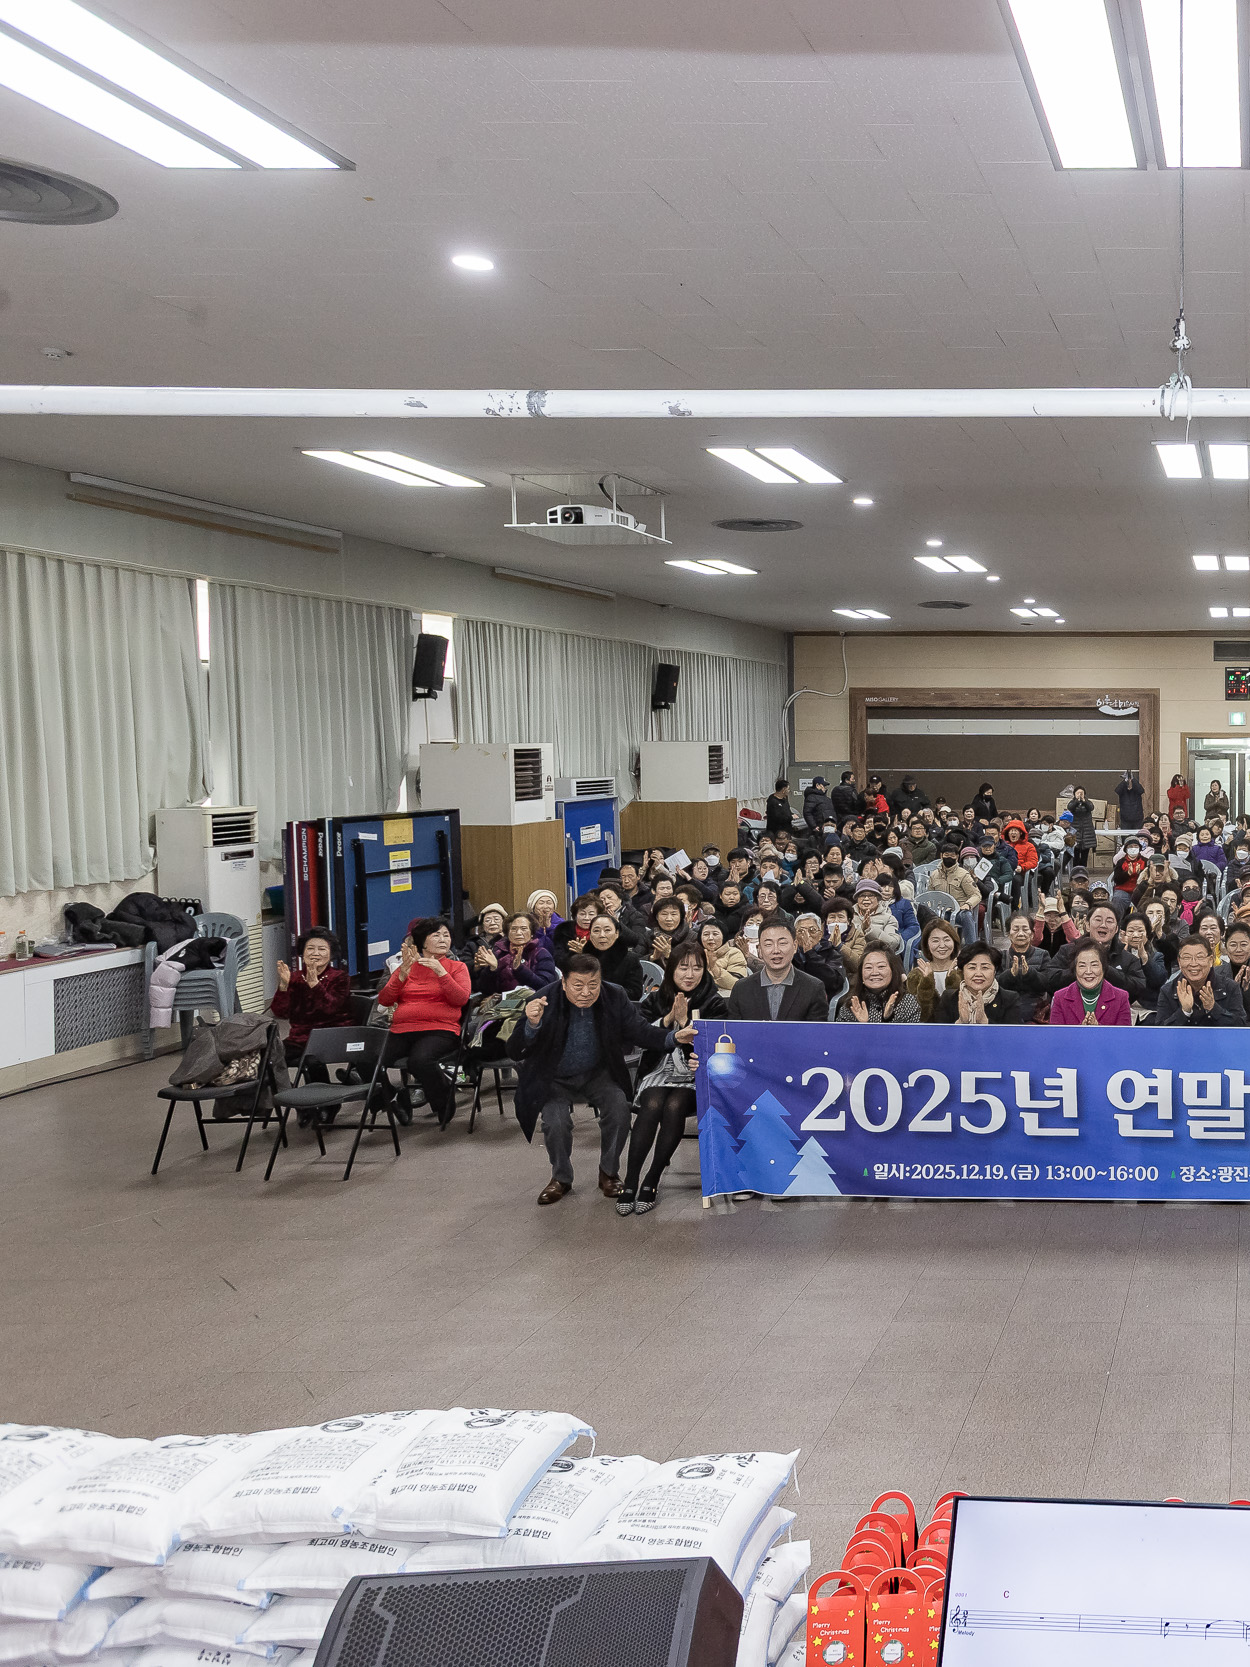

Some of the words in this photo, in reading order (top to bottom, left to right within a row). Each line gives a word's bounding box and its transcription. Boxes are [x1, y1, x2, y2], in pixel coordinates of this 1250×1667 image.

[800, 1066, 1080, 1137] 2025년
[873, 1163, 1041, 1181] 일시:2025.12.19.(금)
[1045, 1164, 1159, 1182] 13:00~16:00
[1003, 1590, 1010, 1598] C
[819, 1629, 850, 1637] Christmas
